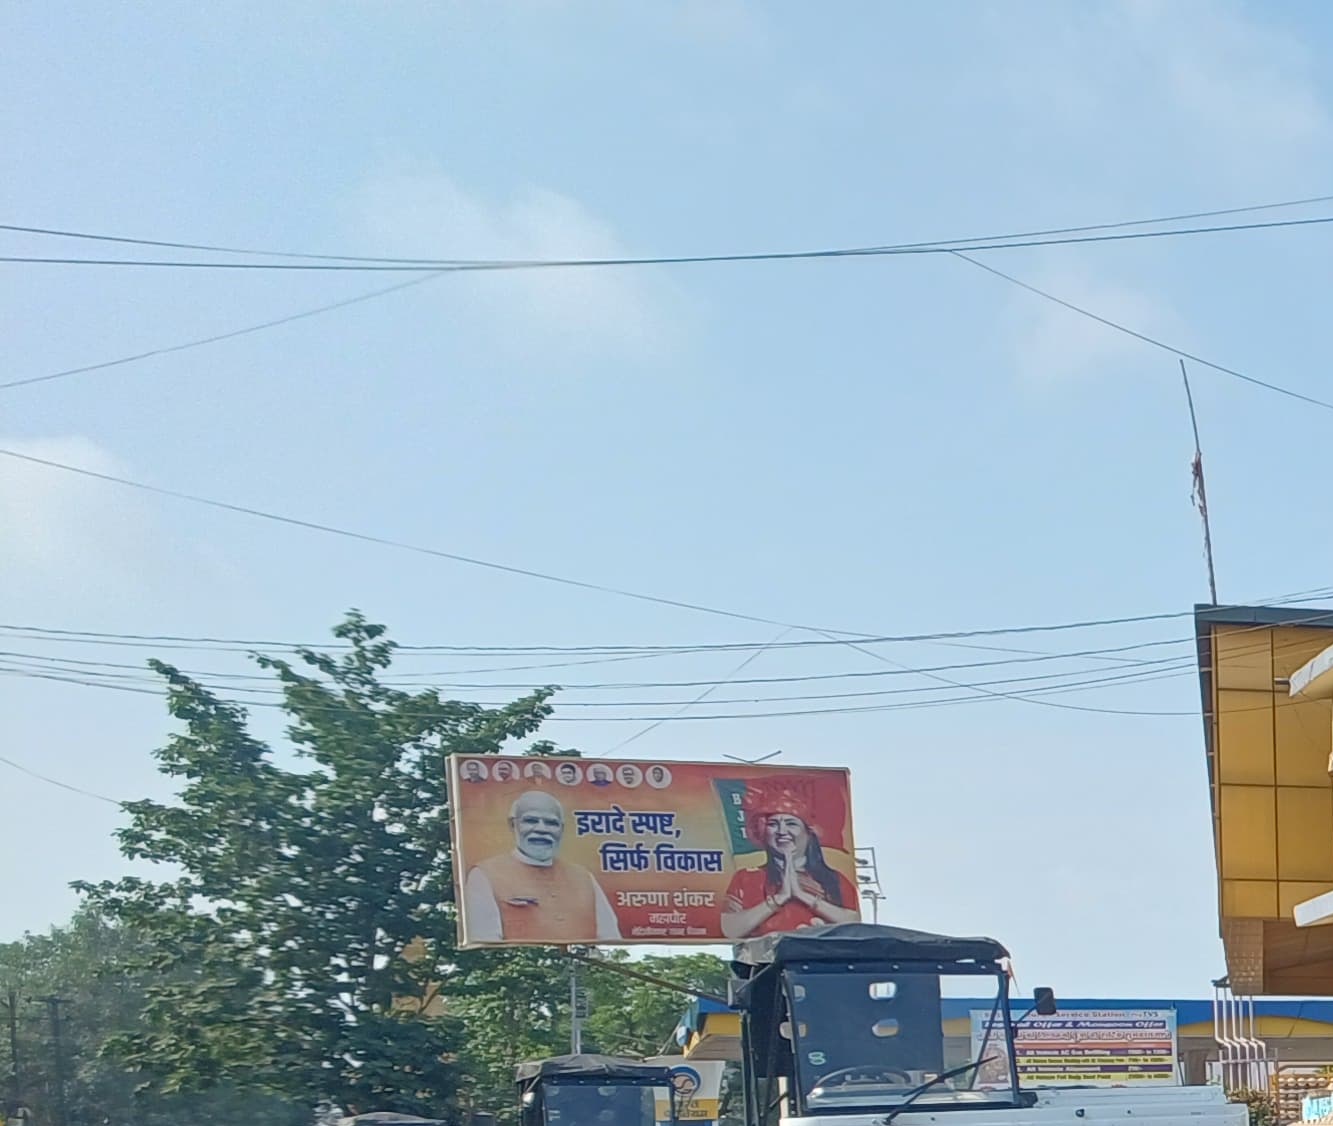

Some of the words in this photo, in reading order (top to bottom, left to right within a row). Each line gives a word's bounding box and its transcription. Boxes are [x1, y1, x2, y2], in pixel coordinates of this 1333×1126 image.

[574, 805, 626, 835] इरादे
[629, 812, 682, 839] स्पष्ट,
[600, 842, 650, 873] सिर्फ
[652, 842, 724, 873] विकास
[616, 891, 669, 908] अरुणा
[673, 887, 716, 908] शंकर
